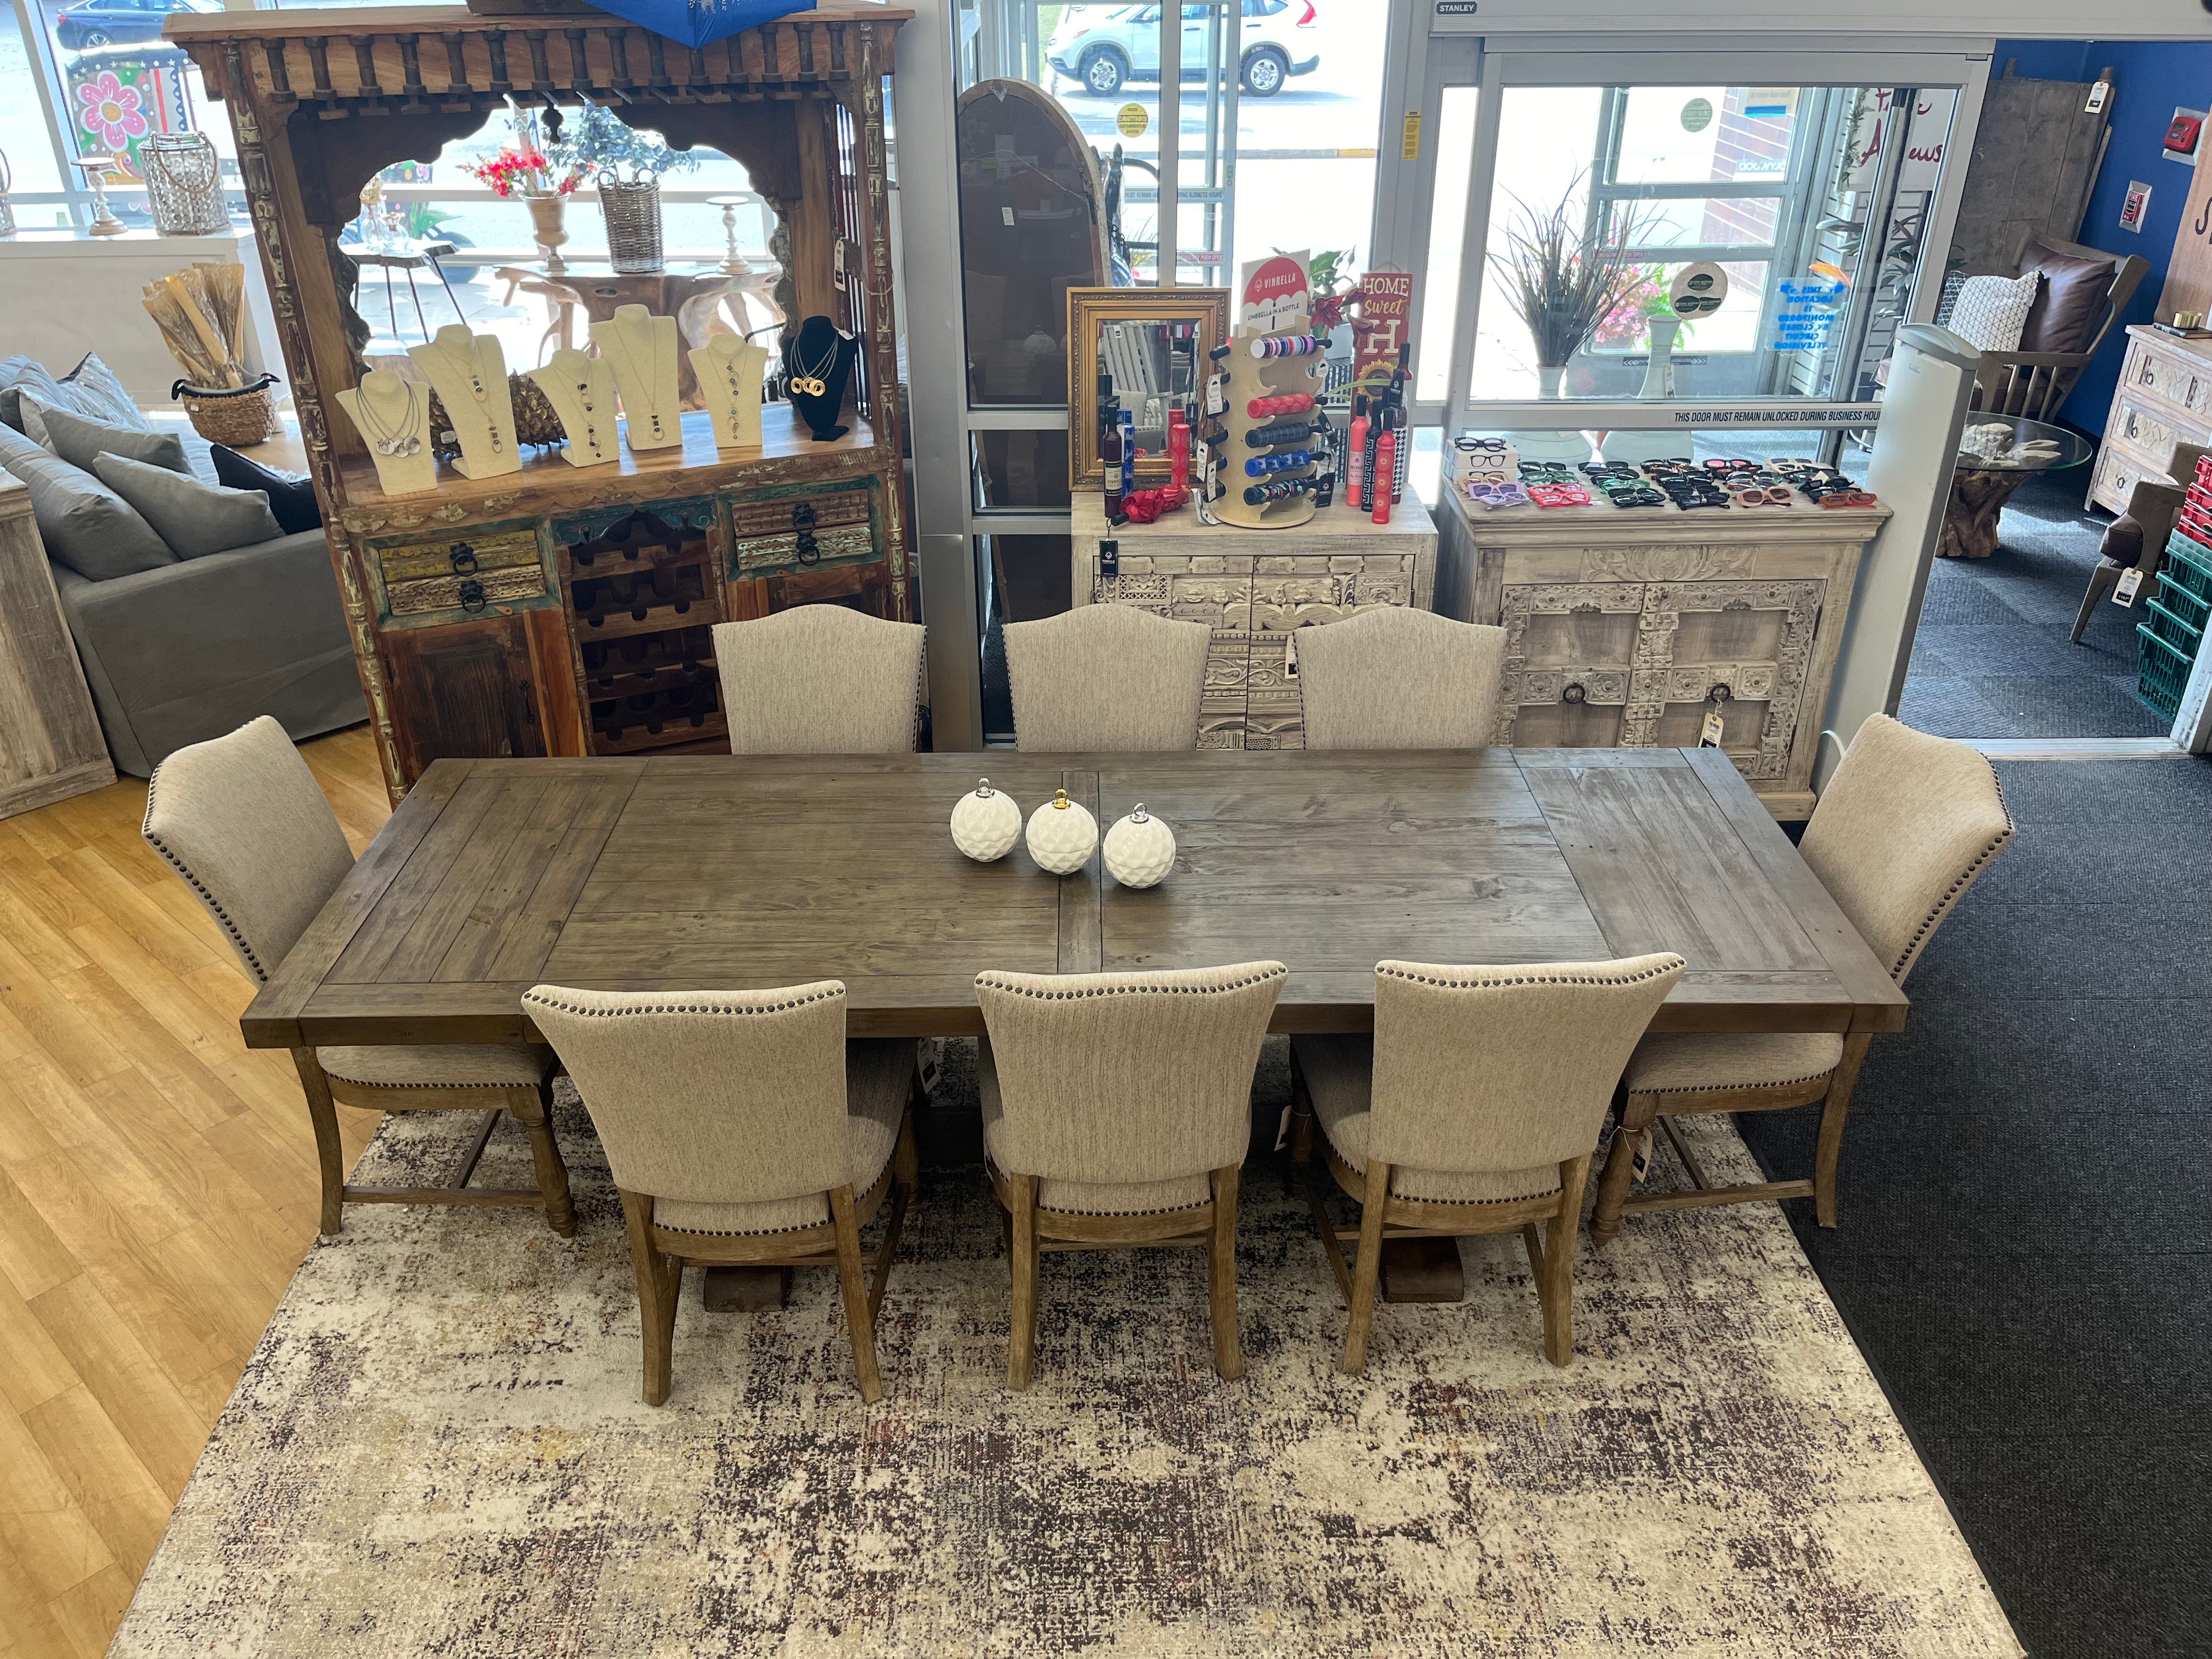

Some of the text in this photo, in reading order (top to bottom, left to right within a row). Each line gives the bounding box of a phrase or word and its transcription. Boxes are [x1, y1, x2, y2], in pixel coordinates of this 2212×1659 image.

[1264, 273, 1296, 289] VINRELLA
[1363, 278, 1409, 297] HOME
[1248, 311, 1272, 320] UMBRELLA
[1282, 303, 1299, 312] BOTTLE
[1364, 299, 1408, 315] sweet
[1675, 413, 1690, 422] THIS
[1691, 413, 1711, 421] DOOR
[1713, 412, 1732, 421] MUST
[1734, 412, 1760, 421] REMAIN
[1762, 411, 1798, 421] UNLOCKED
[1800, 411, 1826, 421] DURING
[1828, 411, 1863, 421] BUSINESS
